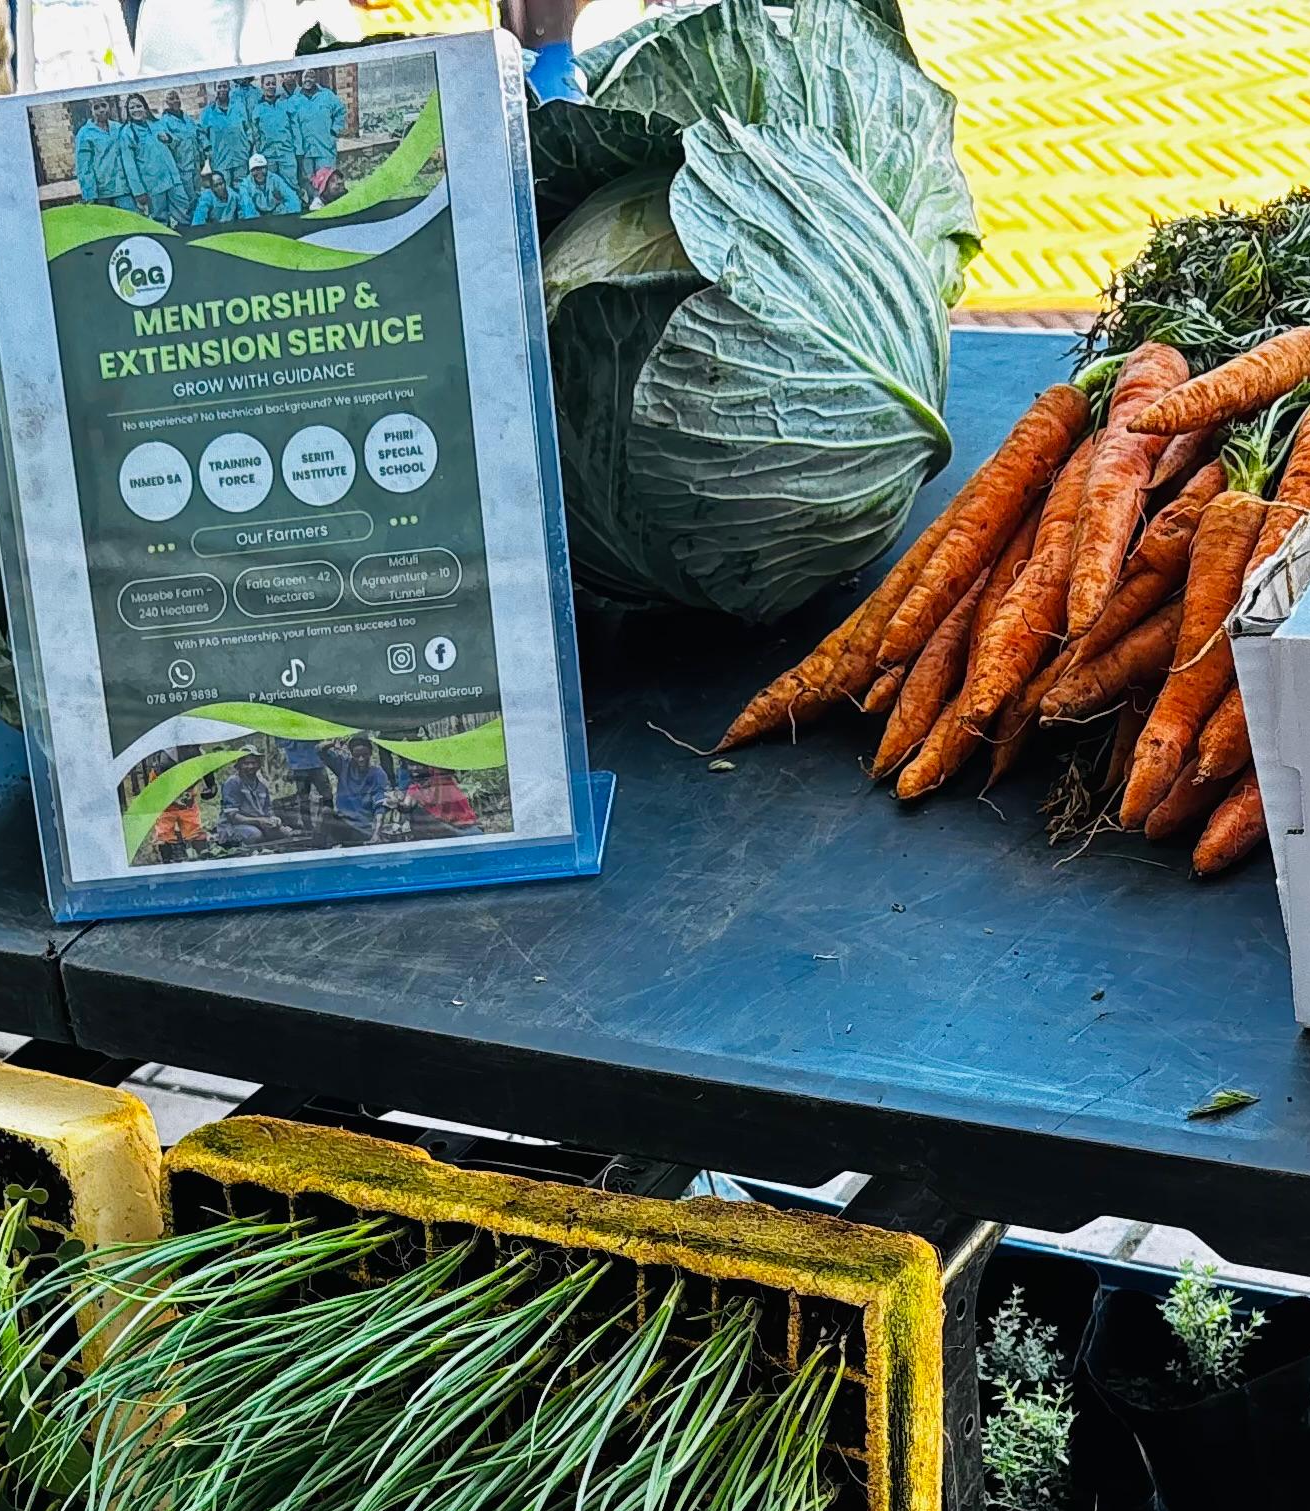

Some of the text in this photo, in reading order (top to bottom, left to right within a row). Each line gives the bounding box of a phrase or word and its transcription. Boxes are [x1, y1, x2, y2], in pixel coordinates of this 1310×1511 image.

[133, 281, 381, 337] MENTORSHIP &
[99, 313, 424, 380] EXTENSION SERVICE
[172, 362, 356, 398] GROW WITH GUIDANCE
[122, 388, 415, 432] No experience? No technical background? We support you
[384, 429, 413, 443] PHIRI
[301, 450, 335, 464] SERITI
[377, 445, 424, 460] SPECIAL
[208, 456, 262, 472] TRAINING
[379, 461, 427, 477] SCHOOL
[129, 473, 183, 489] INMED SA
[218, 473, 256, 488] FORCE
[292, 465, 348, 481] INSTITUTE
[236, 525, 329, 546] Our Farmers
[272, 575, 307, 588] Green
[317, 571, 331, 583] 42
[130, 589, 174, 604] Masebe
[174, 586, 205, 600] Farm
[265, 590, 315, 605] Hectares
[389, 586, 426, 600] Tunnel
[138, 602, 210, 619] 240 Hectares
[174, 639, 198, 651] With
[198, 637, 220, 648] PAG
[282, 627, 305, 641] your
[306, 625, 332, 637] farm
[333, 623, 353, 634] can
[354, 618, 397, 632] succeed
[398, 616, 416, 627] too
[418, 673, 440, 686] Pag
[146, 693, 167, 705] 078
[249, 683, 358, 704] P Agricultural Group
